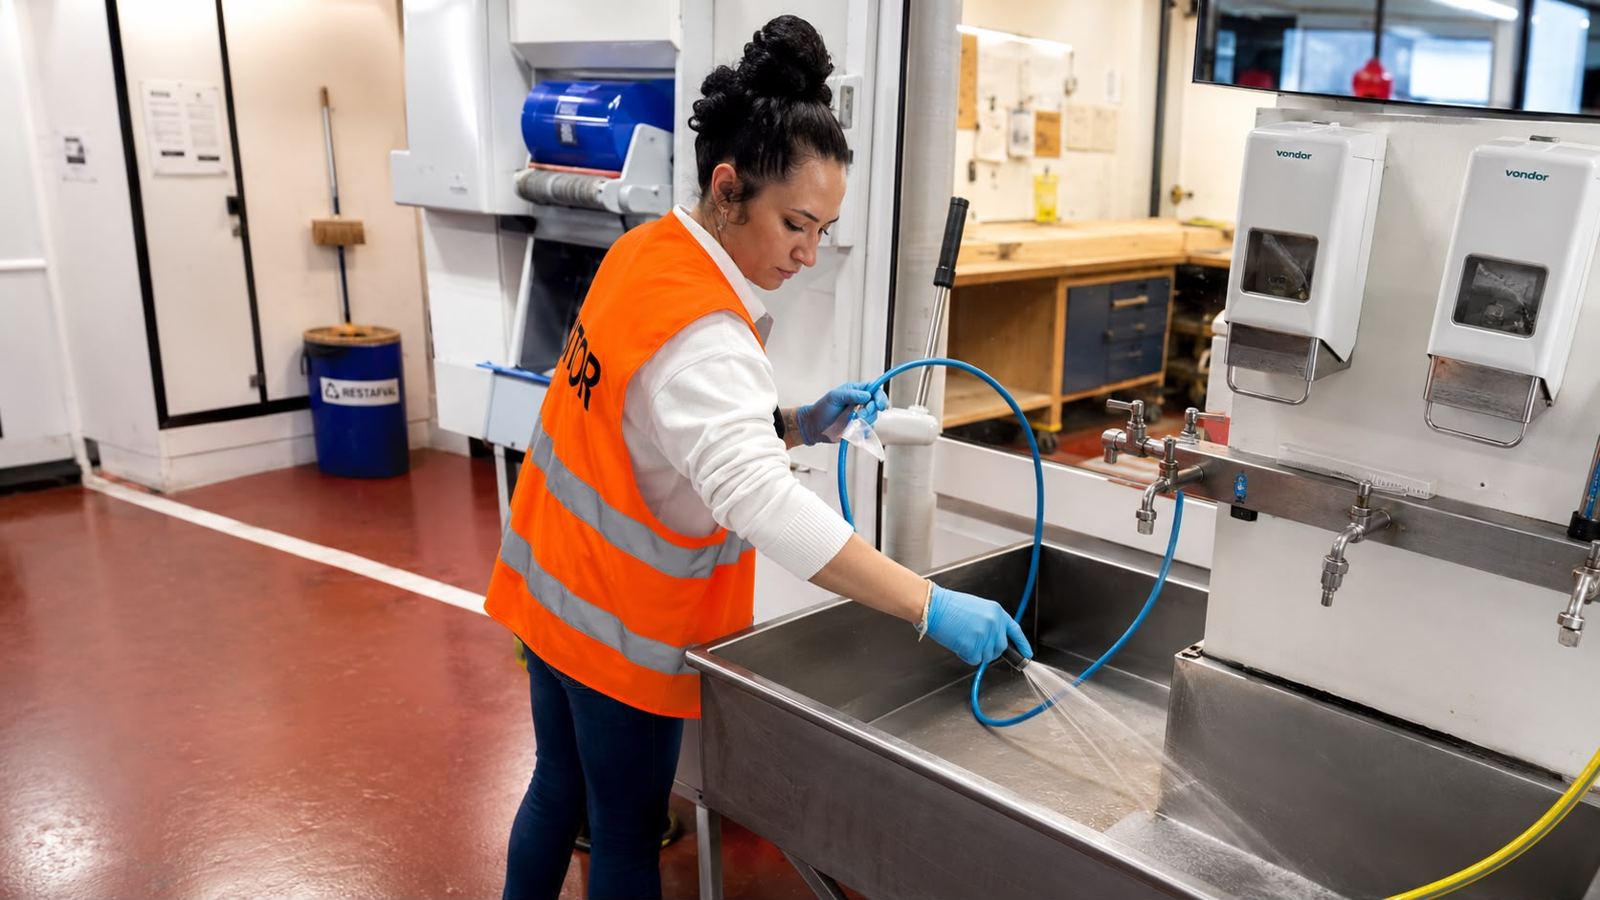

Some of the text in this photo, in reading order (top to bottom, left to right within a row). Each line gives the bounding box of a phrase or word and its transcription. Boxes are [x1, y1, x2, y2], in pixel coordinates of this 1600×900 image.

[1276, 150, 1312, 160] vondor
[1505, 169, 1549, 181] vondor
[563, 320, 601, 411] ITOR
